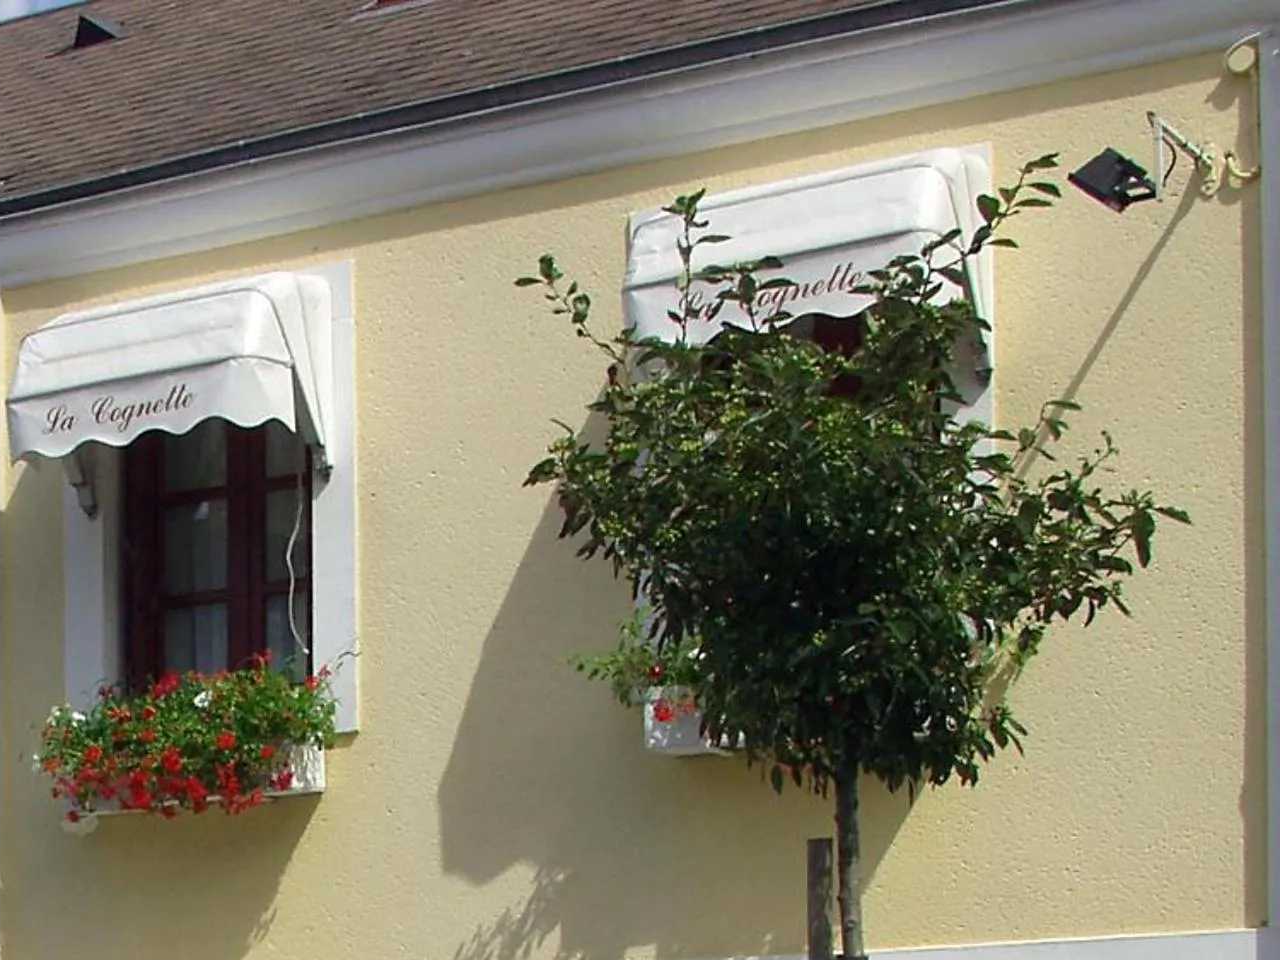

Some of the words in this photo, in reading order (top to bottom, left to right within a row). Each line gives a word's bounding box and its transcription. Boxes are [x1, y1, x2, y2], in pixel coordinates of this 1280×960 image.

[738, 262, 865, 314] ognette
[43, 405, 76, 435] La
[91, 383, 195, 433] Cognette
